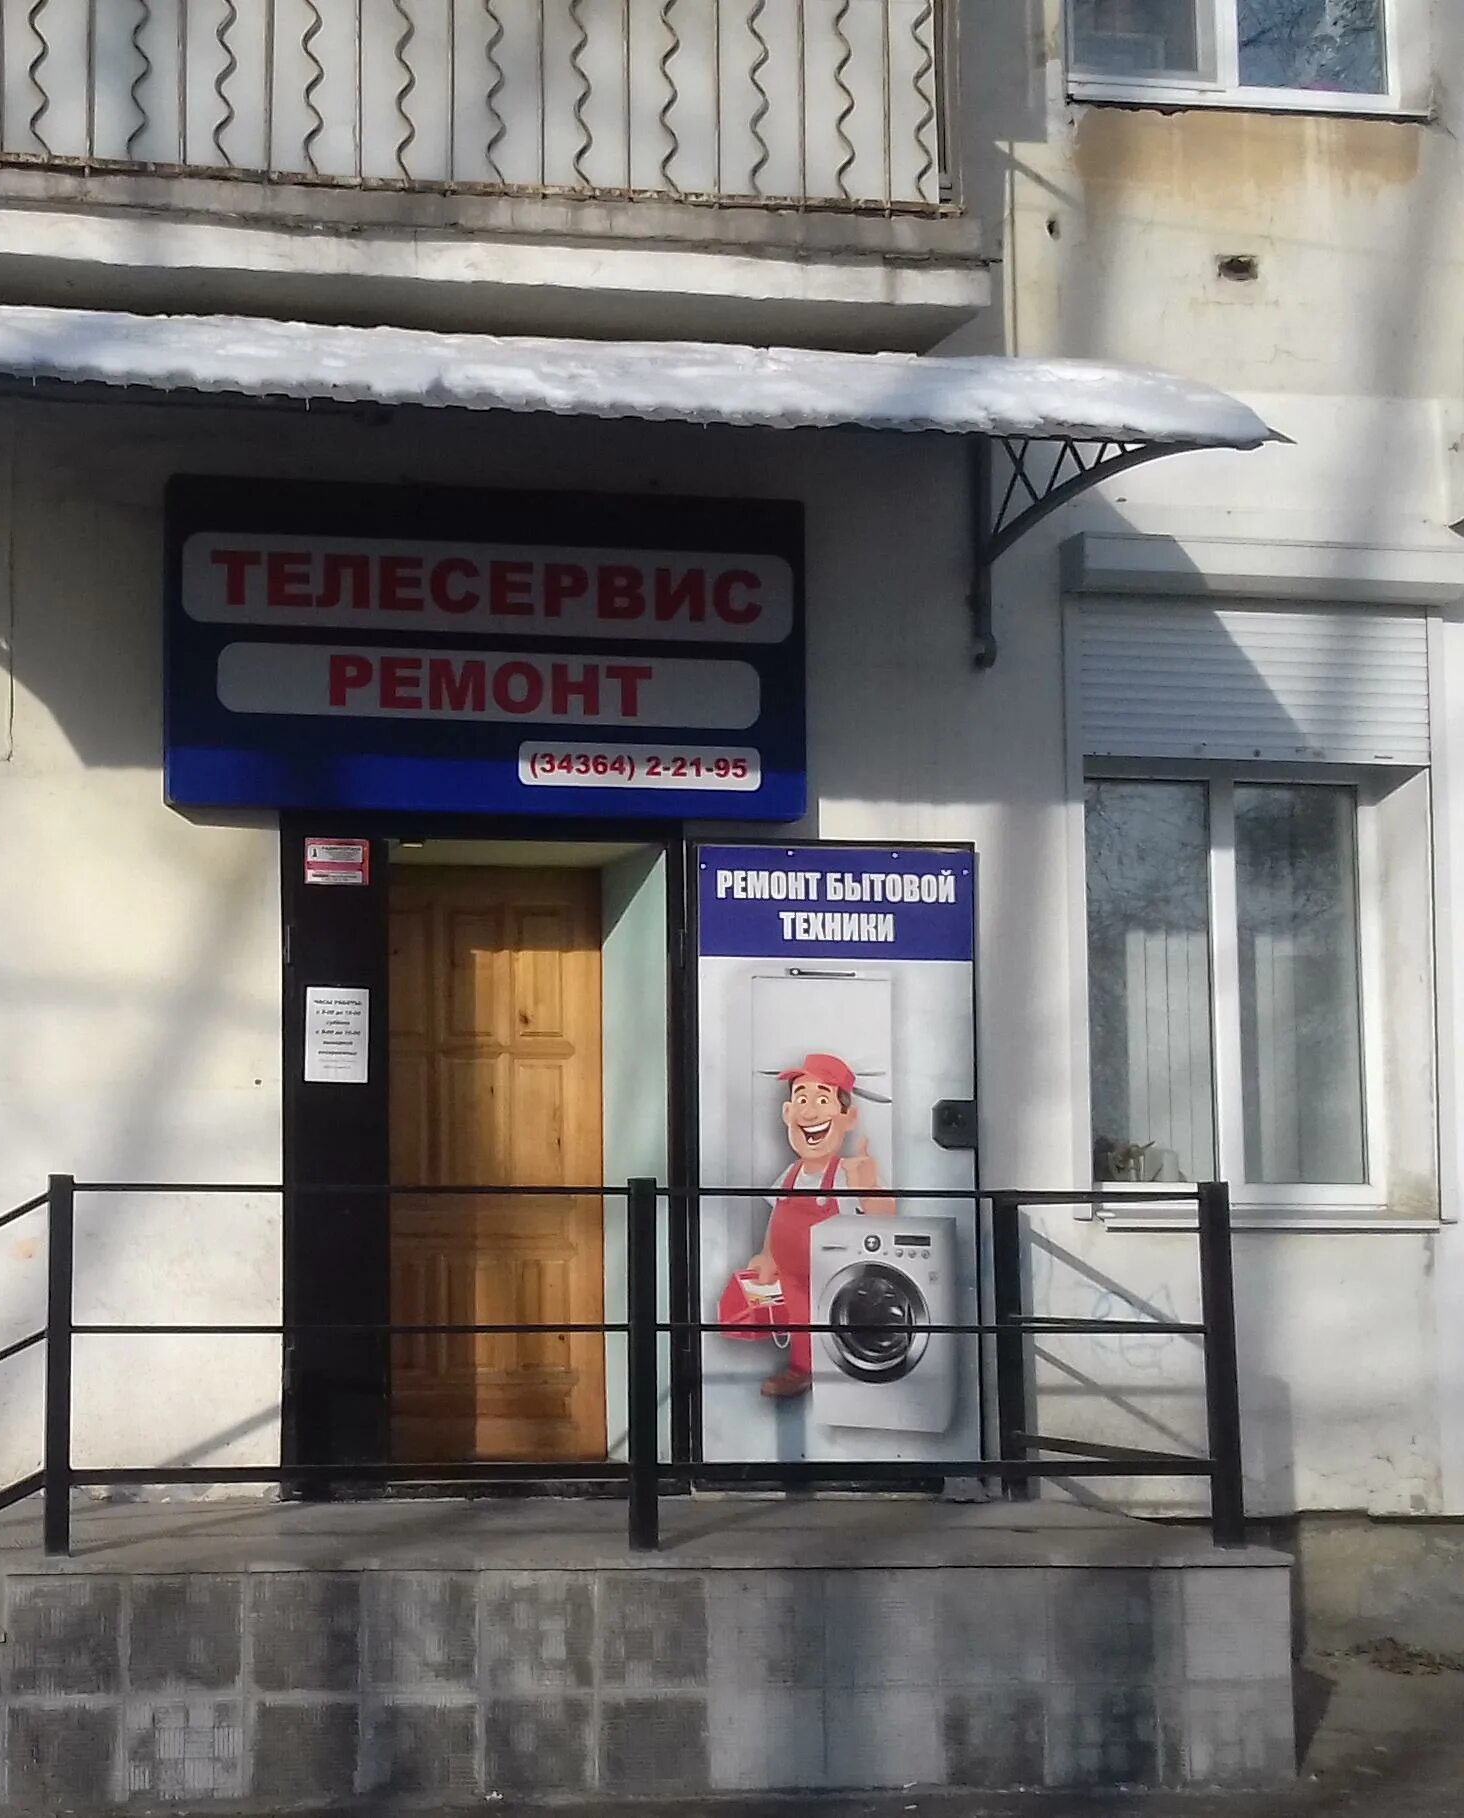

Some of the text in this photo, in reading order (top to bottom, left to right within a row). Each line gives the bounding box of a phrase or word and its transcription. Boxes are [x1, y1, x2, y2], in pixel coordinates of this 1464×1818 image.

[211, 550, 763, 625] ТЕЛЕСЕРВИС
[328, 654, 653, 717] РЕМОНТ
[530, 752, 748, 781] (34364) 2-21-95
[716, 869, 956, 903] РЕМОНТ БЫТОВОЙ
[779, 911, 895, 942] ТЕХНИКИ
